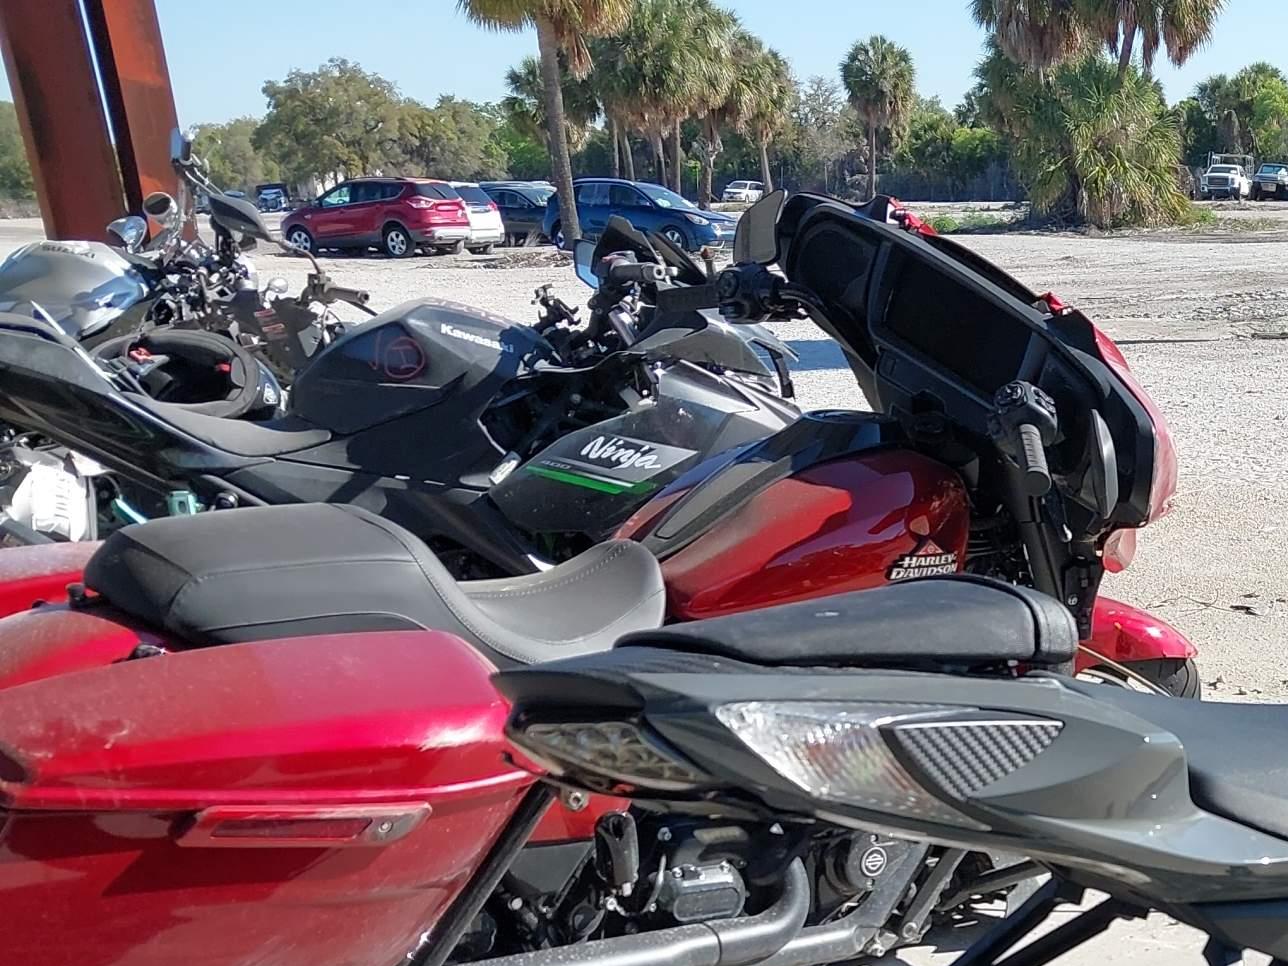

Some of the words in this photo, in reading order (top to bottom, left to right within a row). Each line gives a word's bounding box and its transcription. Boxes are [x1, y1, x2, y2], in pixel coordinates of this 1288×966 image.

[441, 324, 513, 352] Kawasaki
[580, 436, 661, 469] Ninja
[890, 563, 957, 579] DAVIDSON
